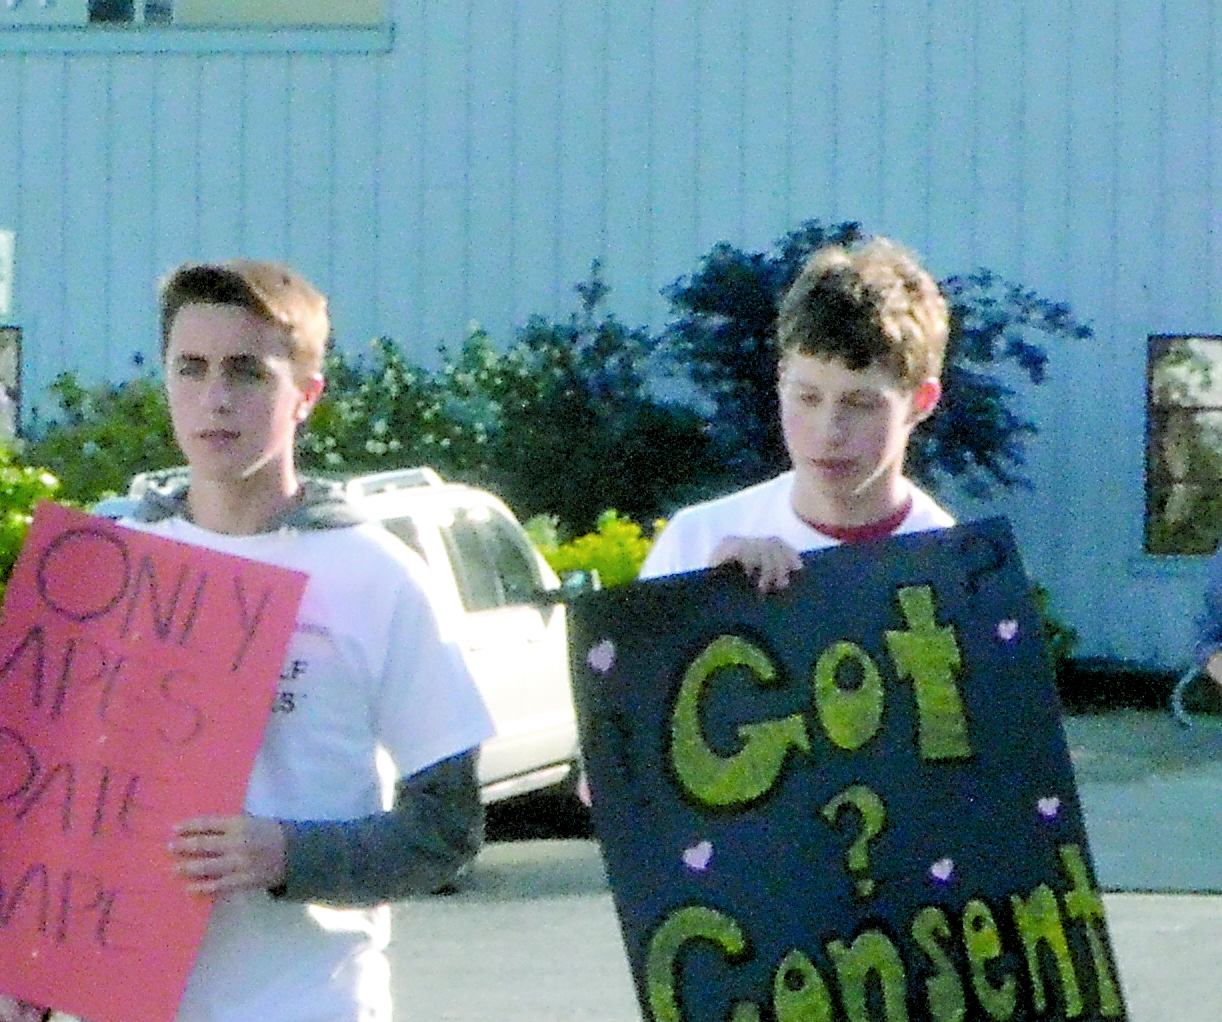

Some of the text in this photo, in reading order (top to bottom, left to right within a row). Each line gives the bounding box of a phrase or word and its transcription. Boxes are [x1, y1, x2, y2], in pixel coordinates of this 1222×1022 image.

[36, 526, 274, 674] ONLY
[668, 583, 977, 809] Got
[820, 783, 888, 898] ?
